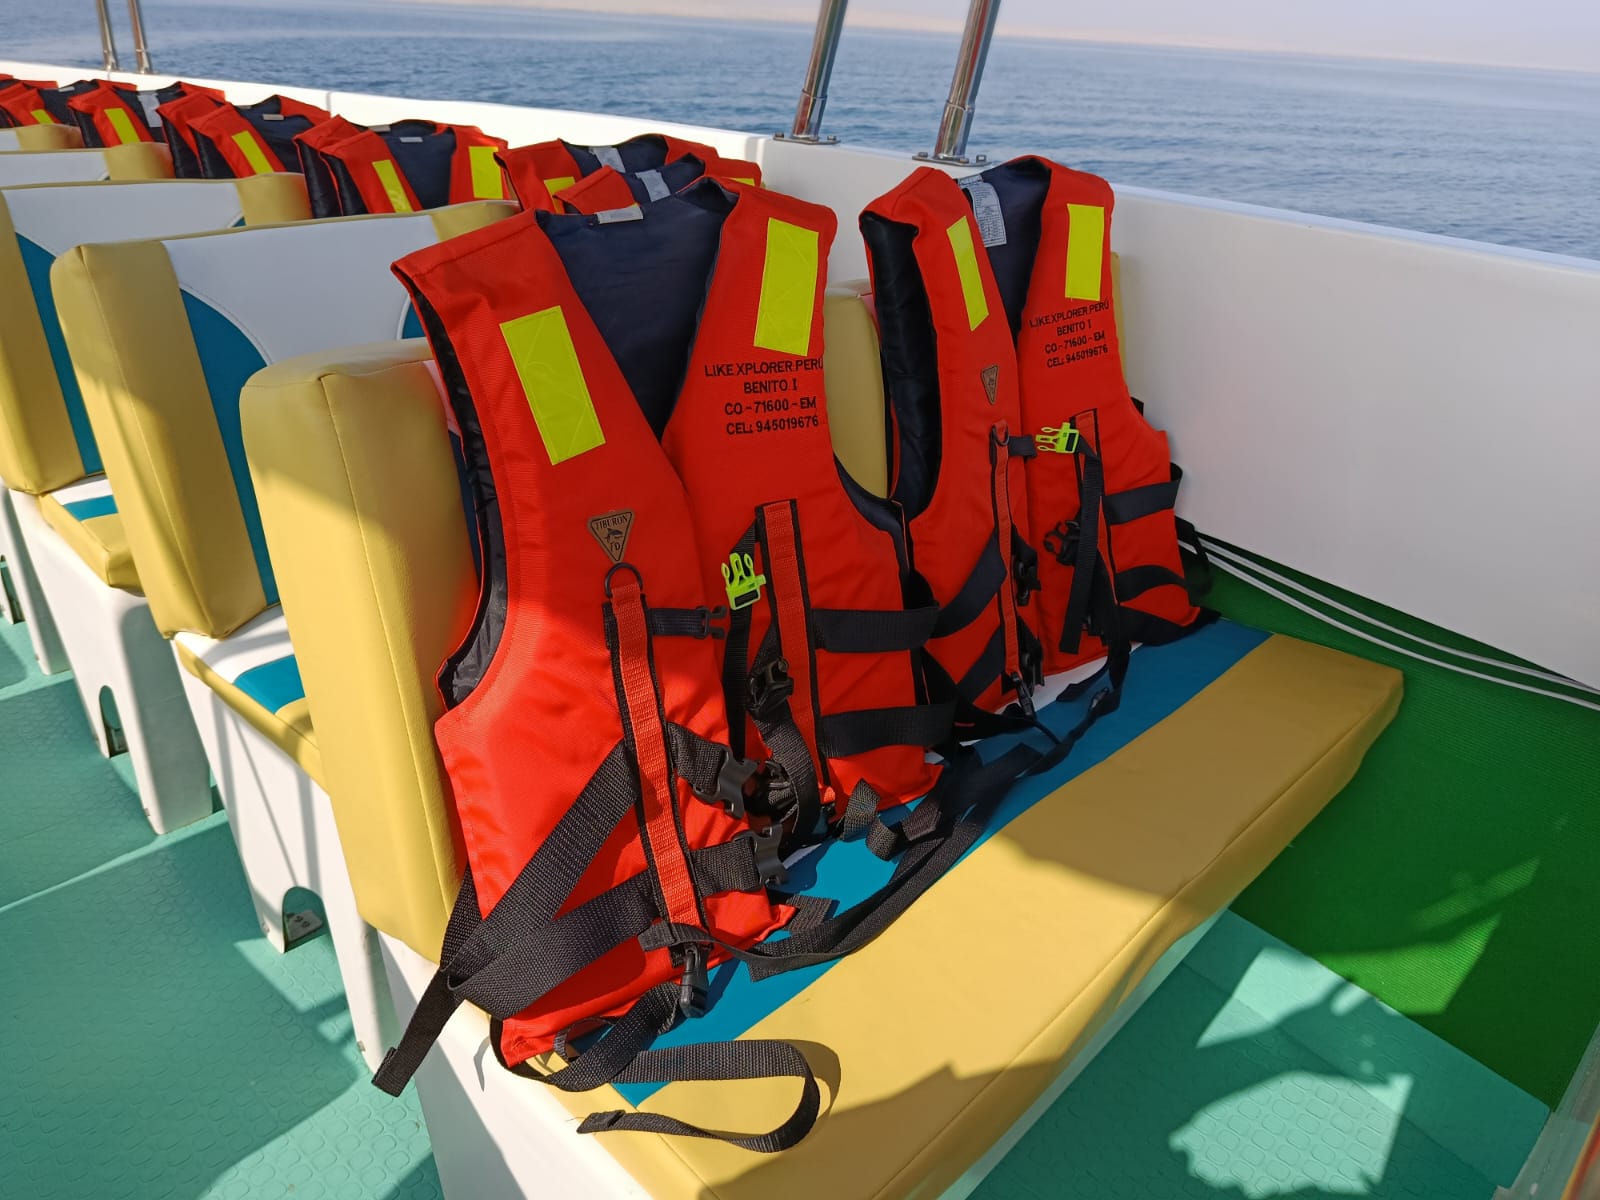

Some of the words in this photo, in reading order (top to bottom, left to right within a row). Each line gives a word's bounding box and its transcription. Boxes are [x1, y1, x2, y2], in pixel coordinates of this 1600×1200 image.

[1029, 315, 1050, 328] LIKE
[1052, 306, 1087, 323] XPLORER
[1057, 321, 1086, 336] BENITO
[704, 363, 734, 377] LIKE
[736, 360, 793, 375] XPLORER
[743, 379, 788, 394] BENITO
[756, 415, 819, 433] 945019676
